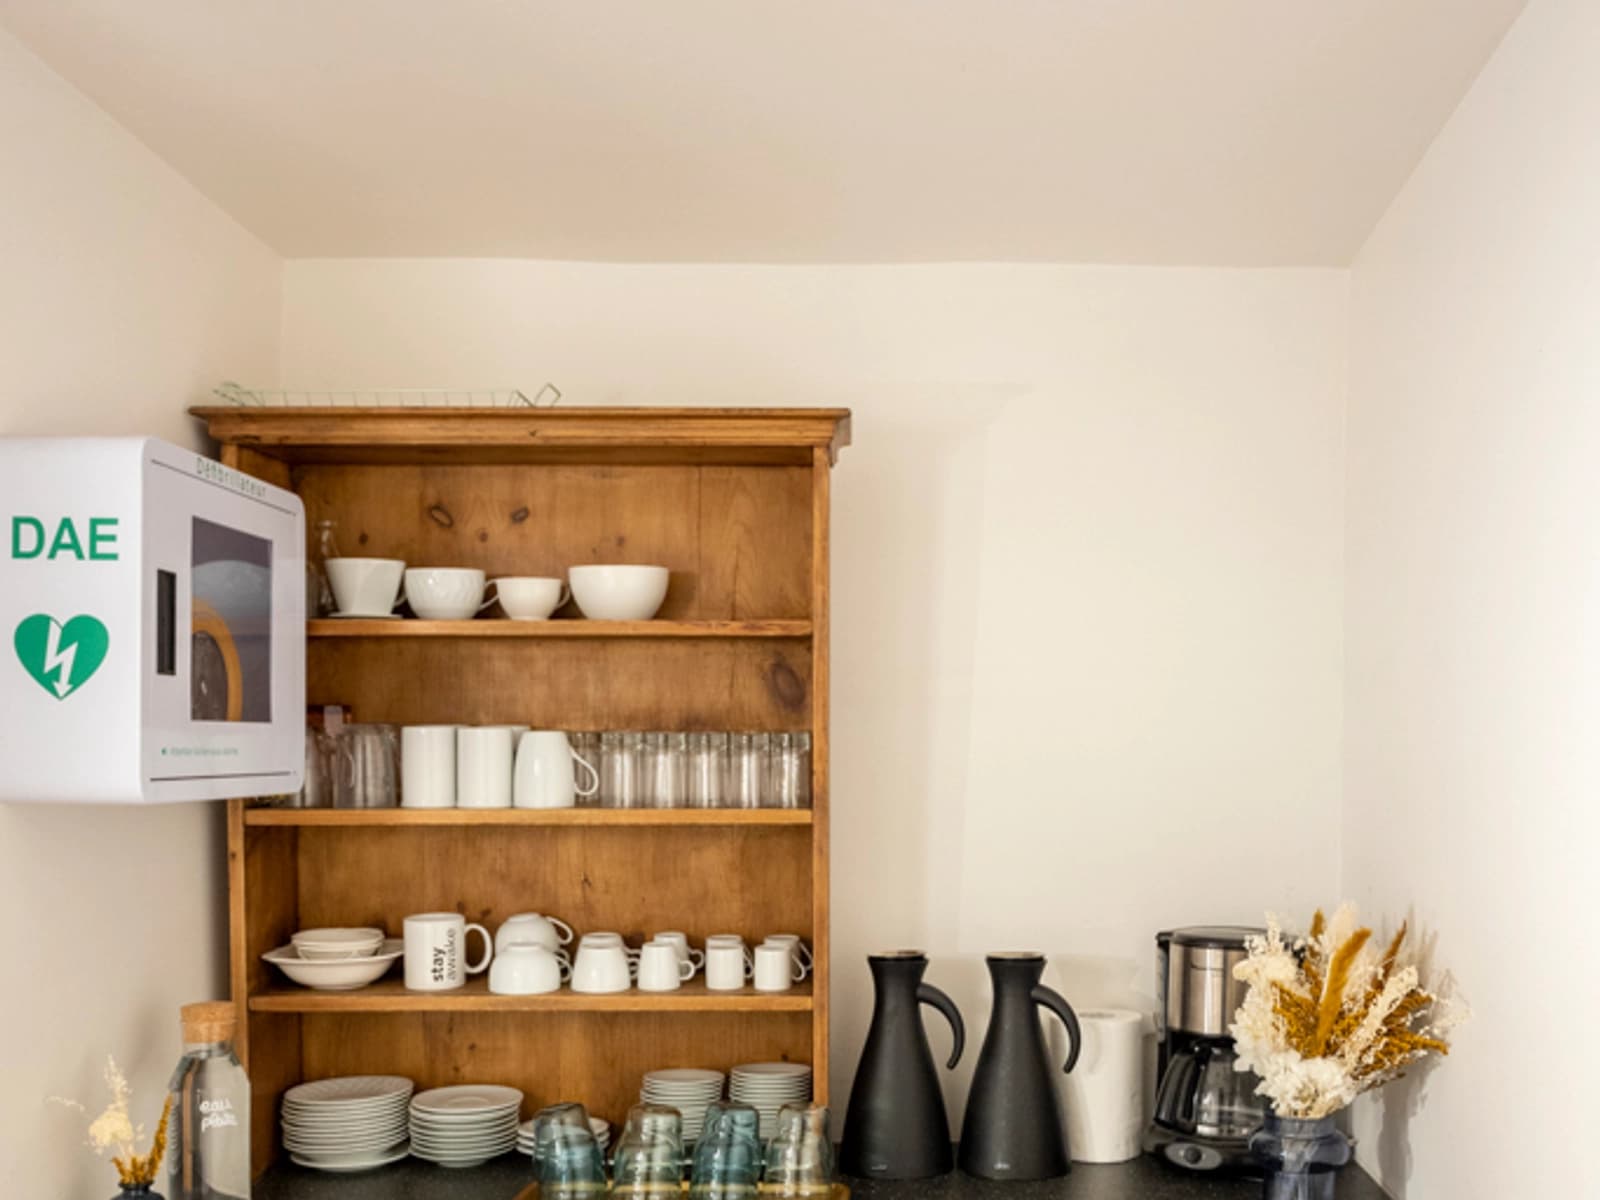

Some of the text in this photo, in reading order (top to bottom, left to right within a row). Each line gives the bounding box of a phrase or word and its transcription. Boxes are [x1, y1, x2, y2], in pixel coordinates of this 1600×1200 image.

[11, 516, 119, 560] DAE
[431, 946, 446, 982] stay
[199, 1098, 233, 1114] eau
